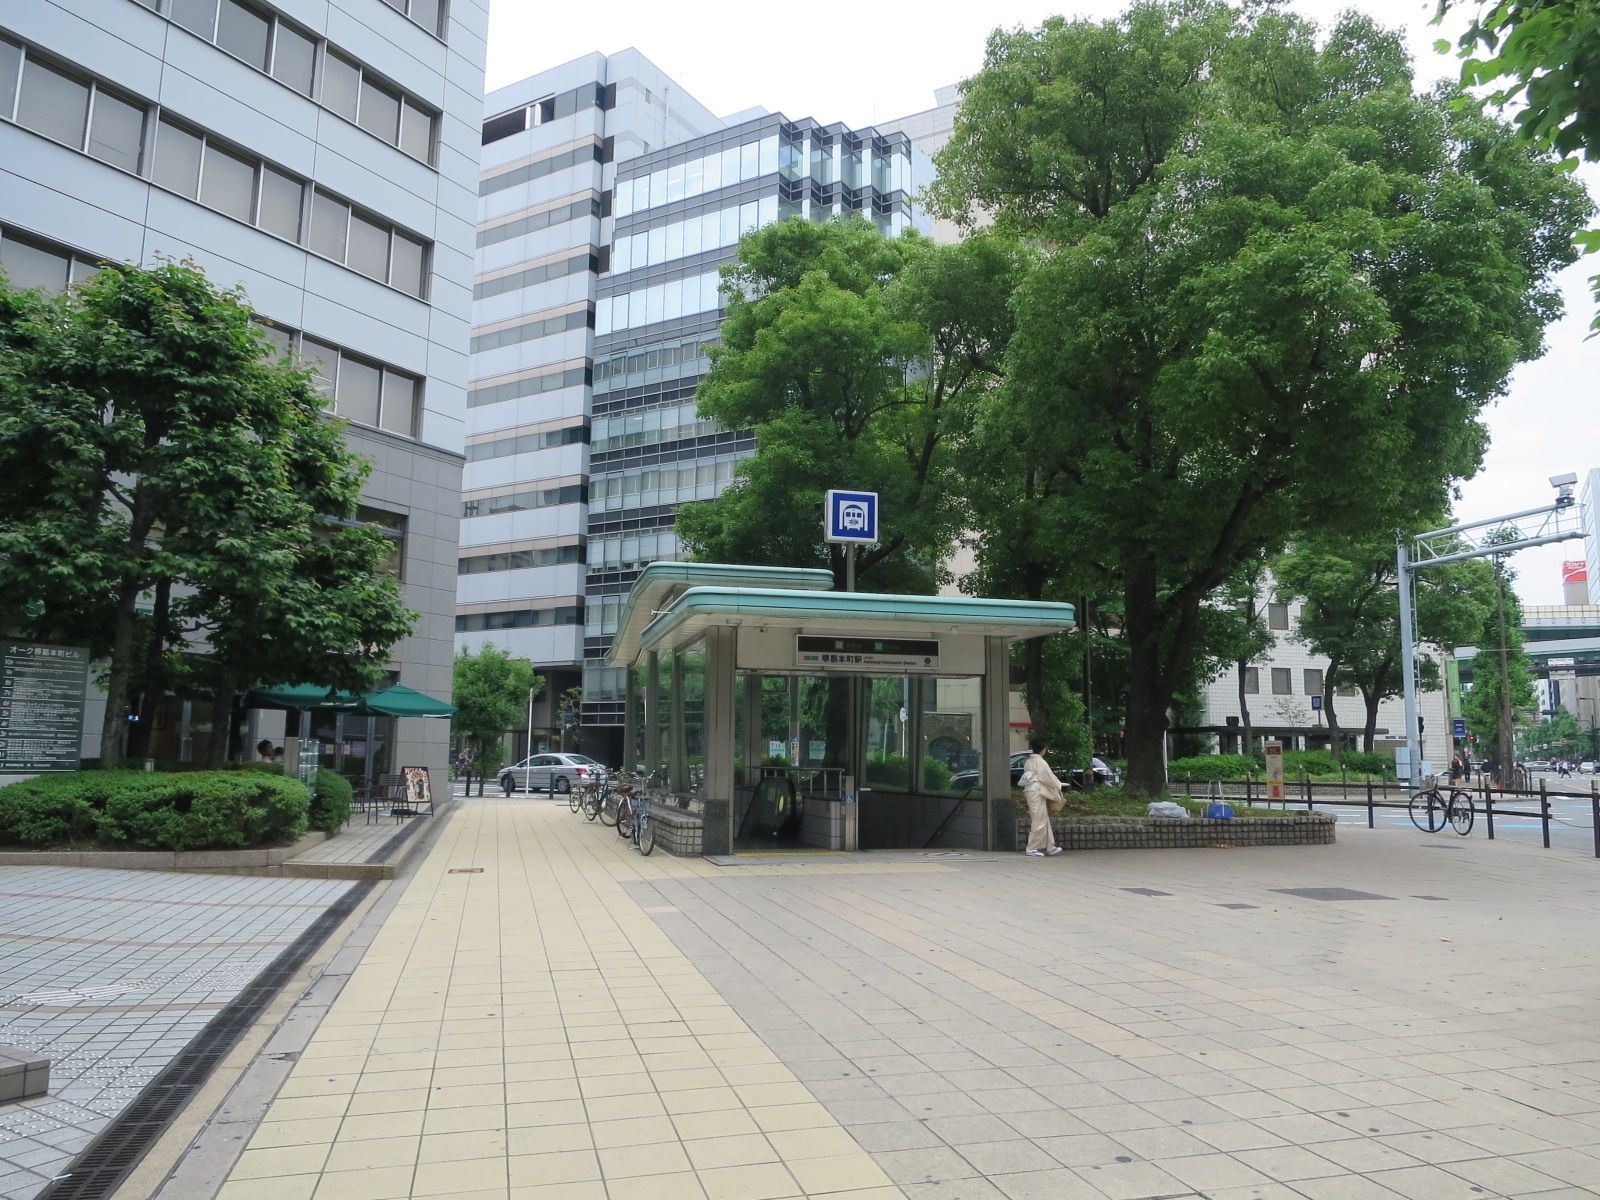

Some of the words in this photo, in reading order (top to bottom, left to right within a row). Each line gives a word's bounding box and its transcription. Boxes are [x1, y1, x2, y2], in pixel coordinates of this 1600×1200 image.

[822, 654, 863, 664] 堺筋本町駅
